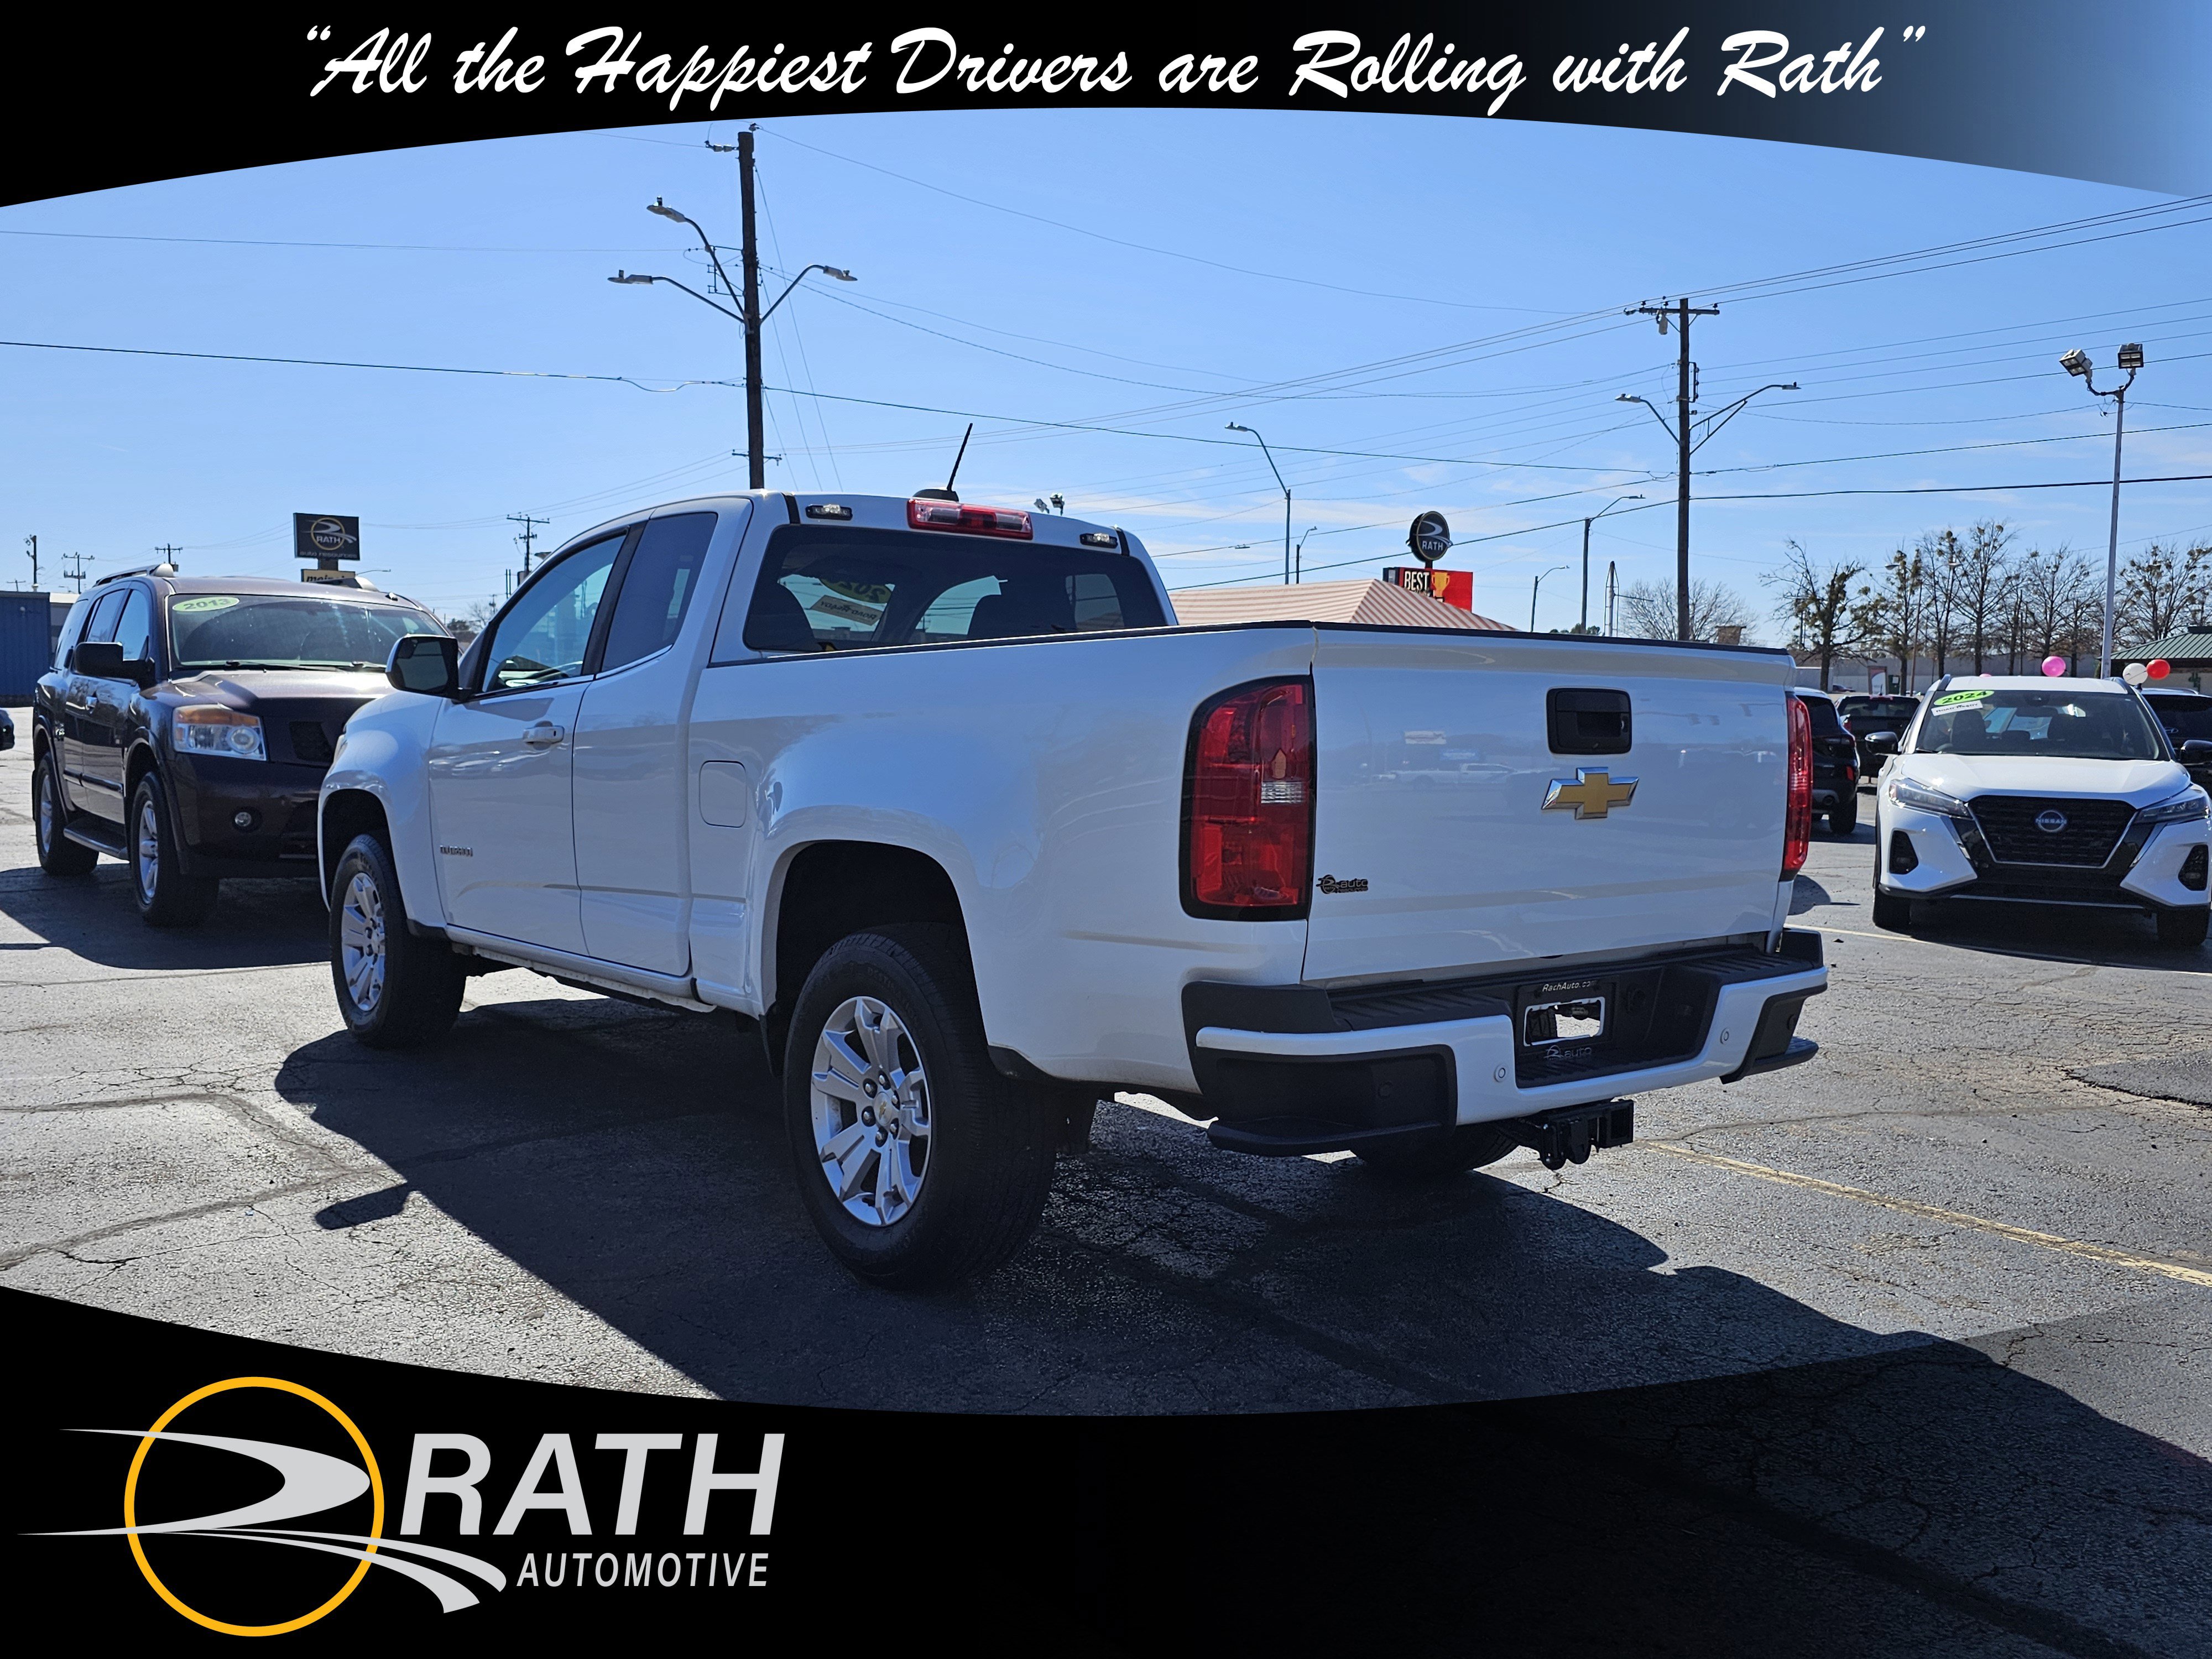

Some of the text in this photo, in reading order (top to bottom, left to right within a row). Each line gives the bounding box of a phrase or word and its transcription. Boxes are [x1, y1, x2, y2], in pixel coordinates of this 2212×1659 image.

[316, 535, 341, 544] RATH
[1422, 540, 1444, 551] RATH
[1405, 571, 1430, 591] BEST
[184, 598, 231, 610] 2013
[1942, 691, 1989, 705] 2024
